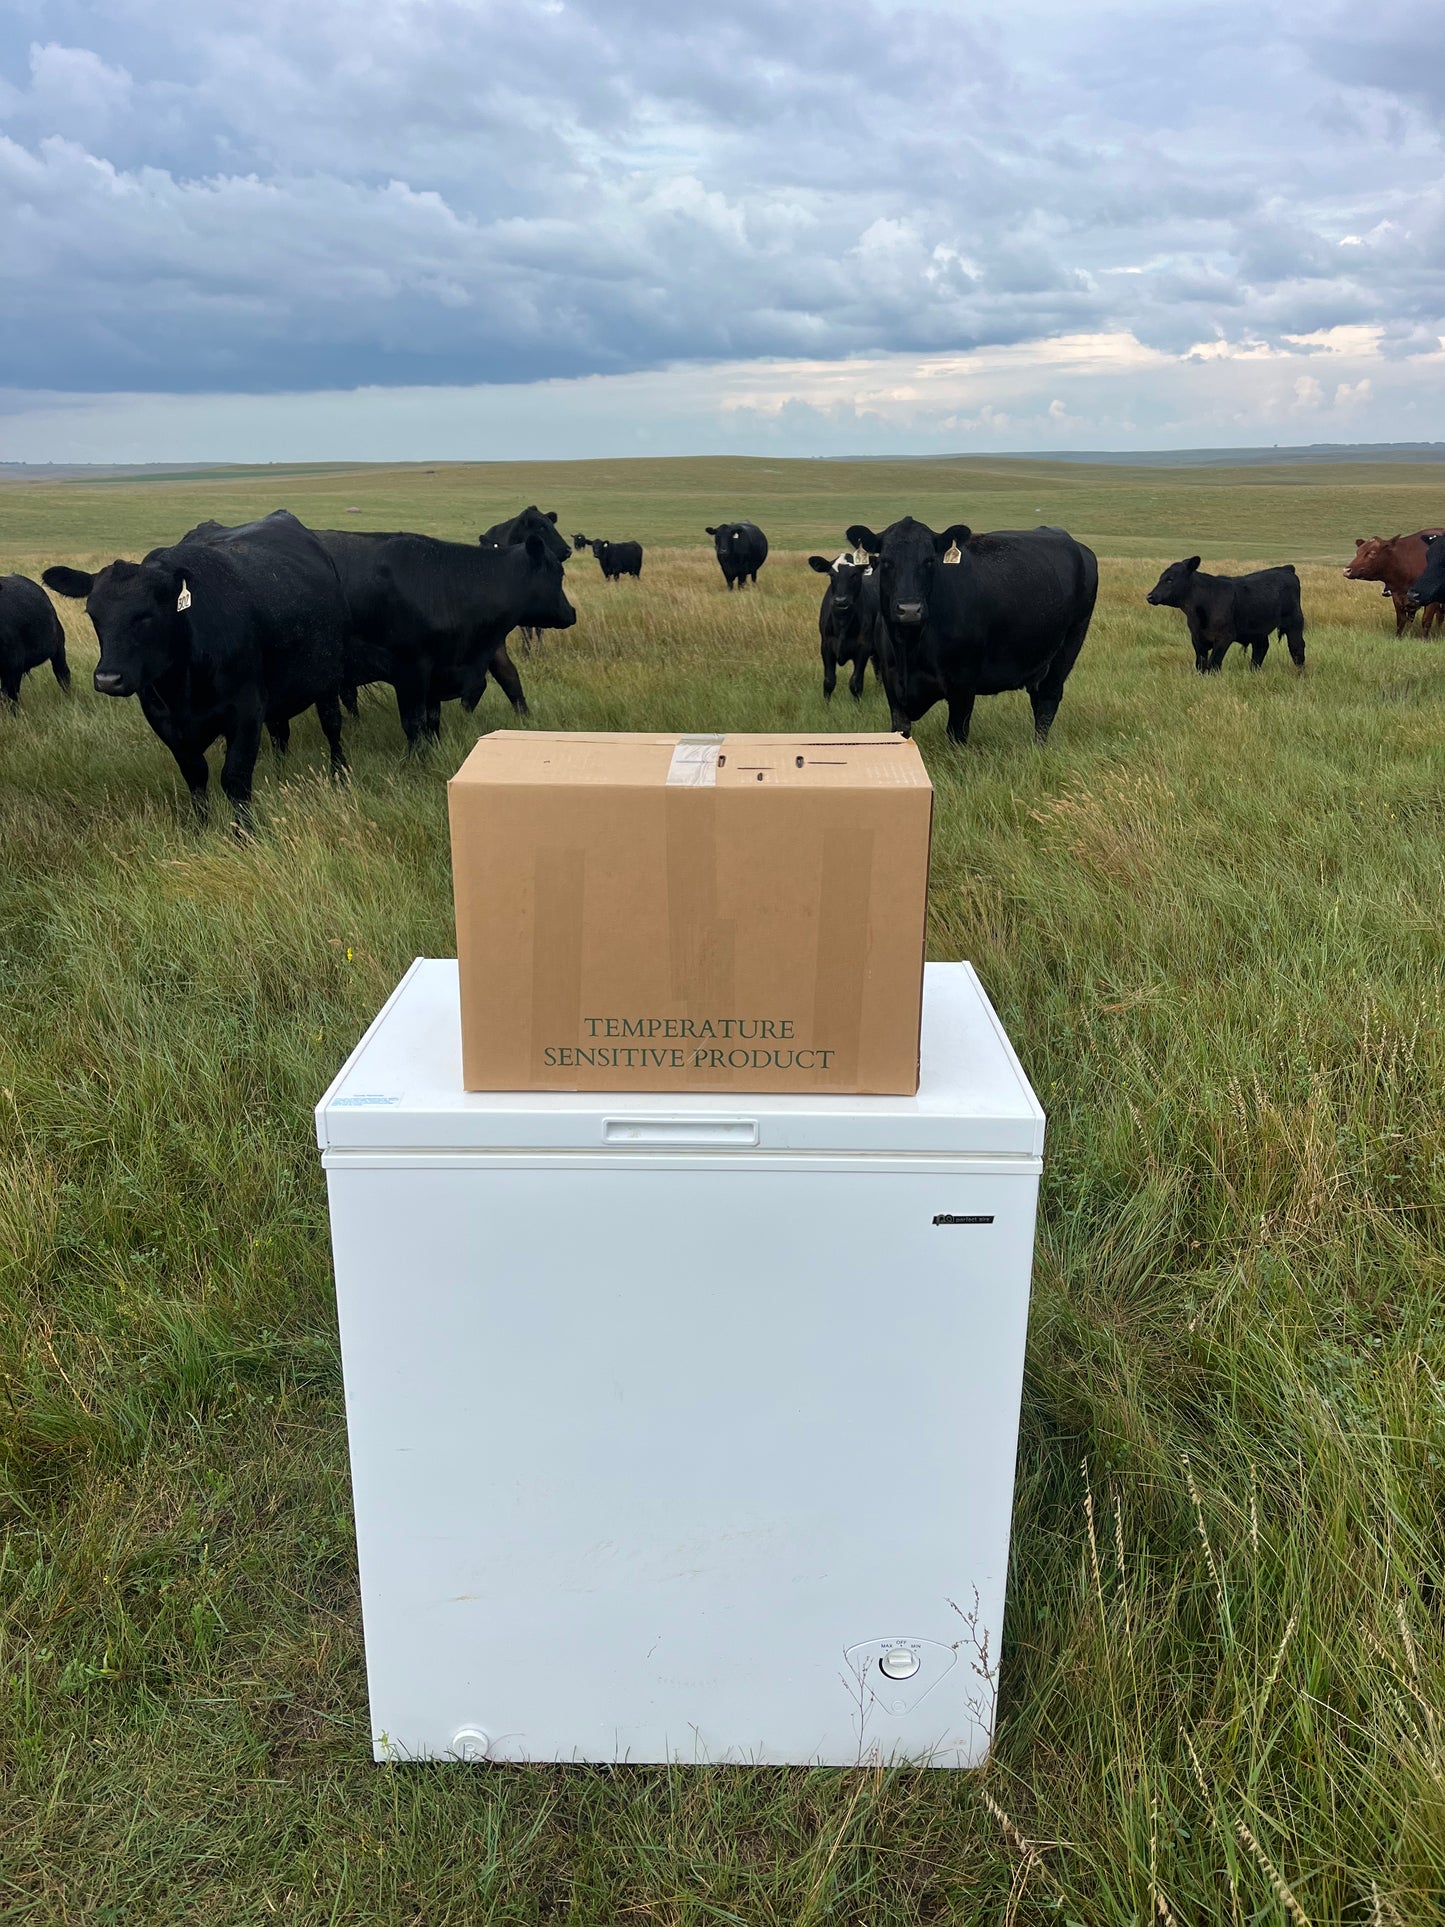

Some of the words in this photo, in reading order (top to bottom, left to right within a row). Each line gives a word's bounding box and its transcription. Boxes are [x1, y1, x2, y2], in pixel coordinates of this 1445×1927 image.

[584, 1017, 795, 1039] TEMPERATURE
[543, 1047, 685, 1067] SENSITIVE
[692, 1048, 836, 1069] PRODUCT
